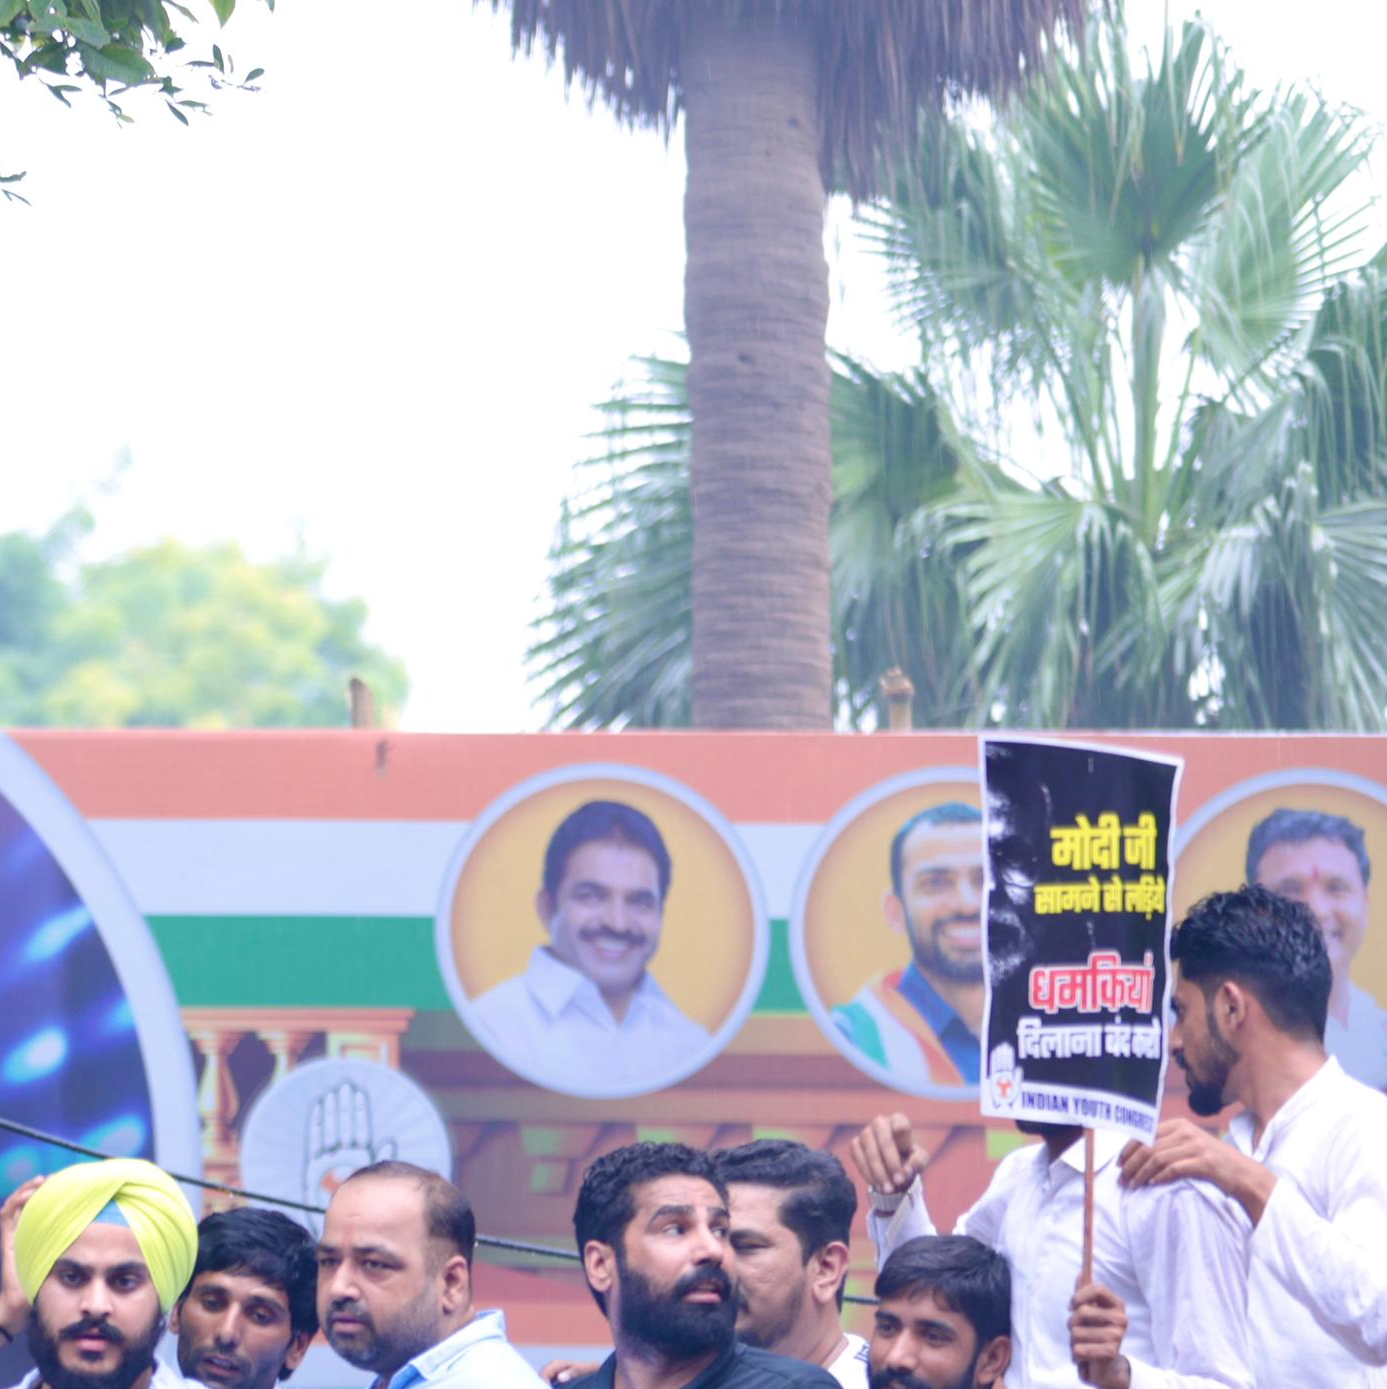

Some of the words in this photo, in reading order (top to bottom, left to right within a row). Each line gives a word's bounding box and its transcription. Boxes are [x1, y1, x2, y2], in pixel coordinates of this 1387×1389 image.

[1050, 812, 1121, 870] मोदी
[1123, 811, 1157, 870] जी
[1034, 874, 1101, 914] सामने
[1102, 874, 1123, 912] से
[1029, 949, 1155, 1014] धमकियां
[1017, 1016, 1103, 1059] दिलाना
[1022, 1091, 1069, 1113] INDIAN
[1072, 1098, 1111, 1121] YOUTH
